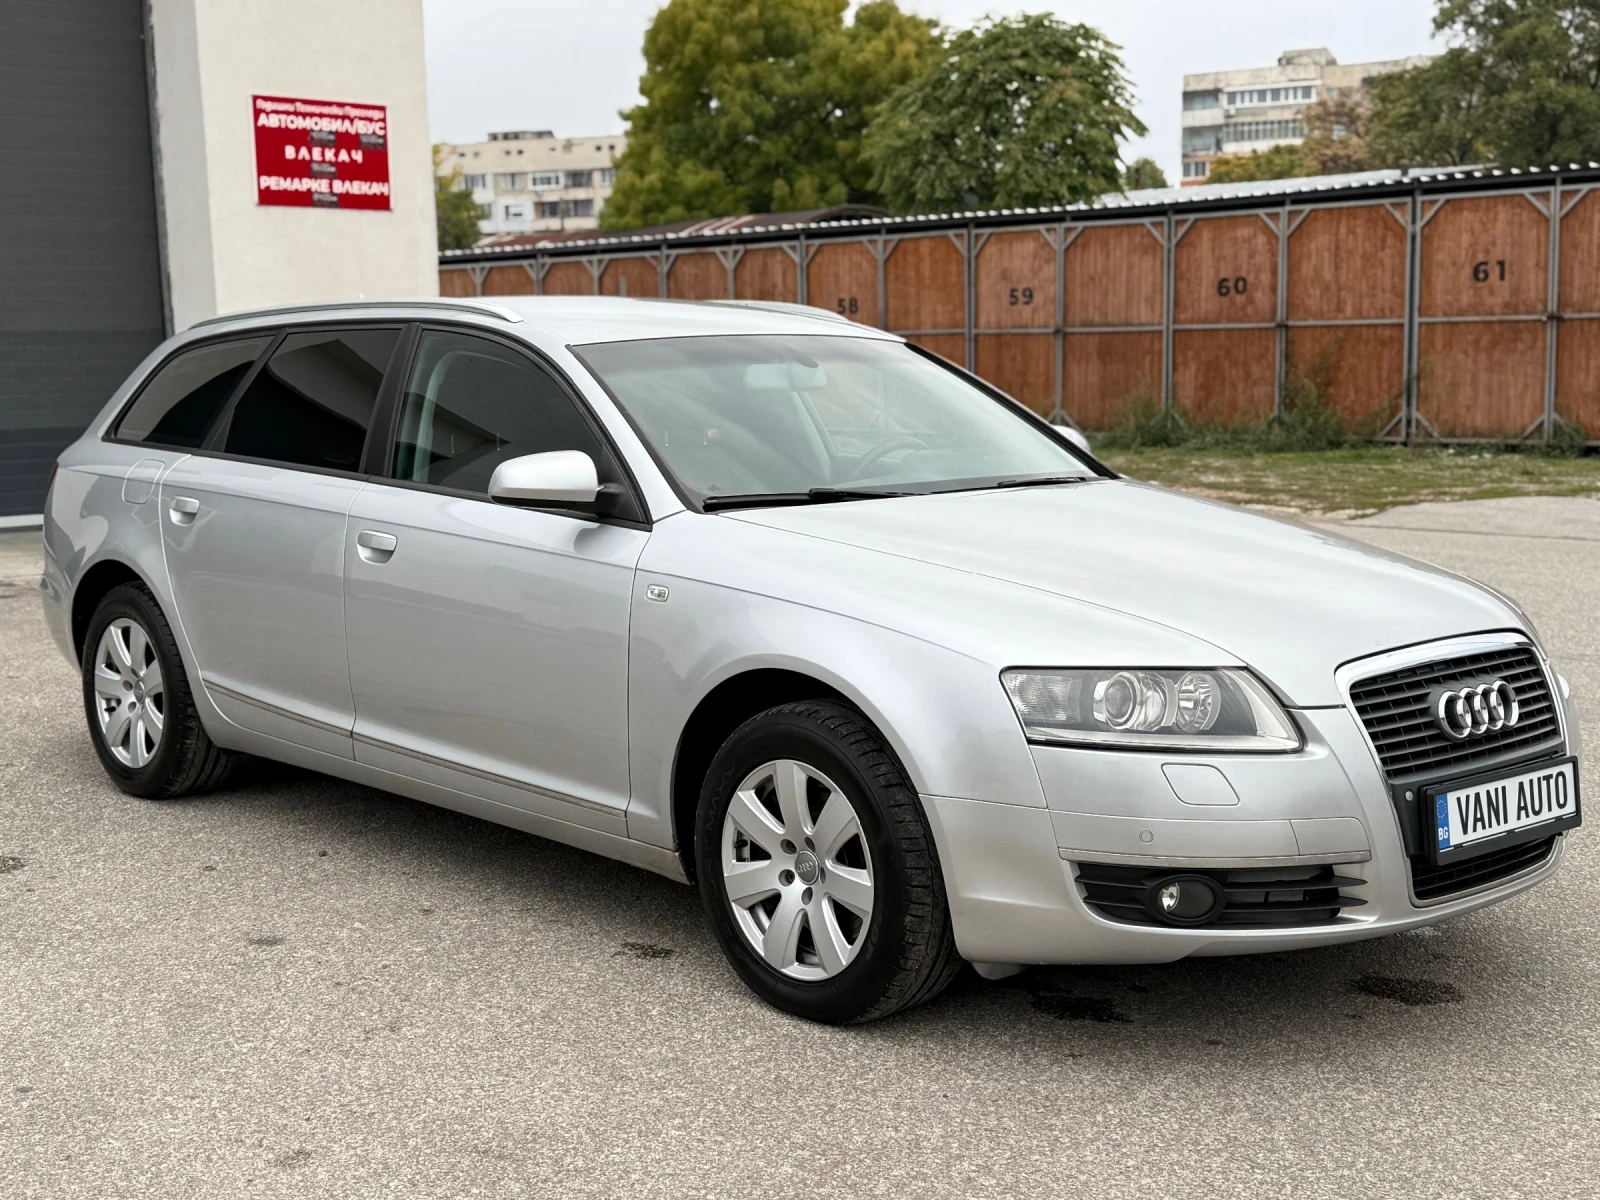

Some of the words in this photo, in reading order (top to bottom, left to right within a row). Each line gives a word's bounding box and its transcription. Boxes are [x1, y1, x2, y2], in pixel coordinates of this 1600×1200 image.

[257, 113, 386, 135] АВТОМОБИЛ/БУС
[284, 145, 363, 164] ВЛЕКАЧ
[259, 175, 331, 193] РЕМАРКЕ
[332, 179, 389, 196] ВЛЕКАЧ
[1473, 260, 1506, 282] 61
[1009, 287, 1034, 306] 59
[1217, 276, 1248, 297] 60
[837, 297, 858, 314] 58
[1456, 786, 1509, 836] VANI
[1516, 771, 1568, 821] AUTO
[1438, 826, 1449, 840] BG
